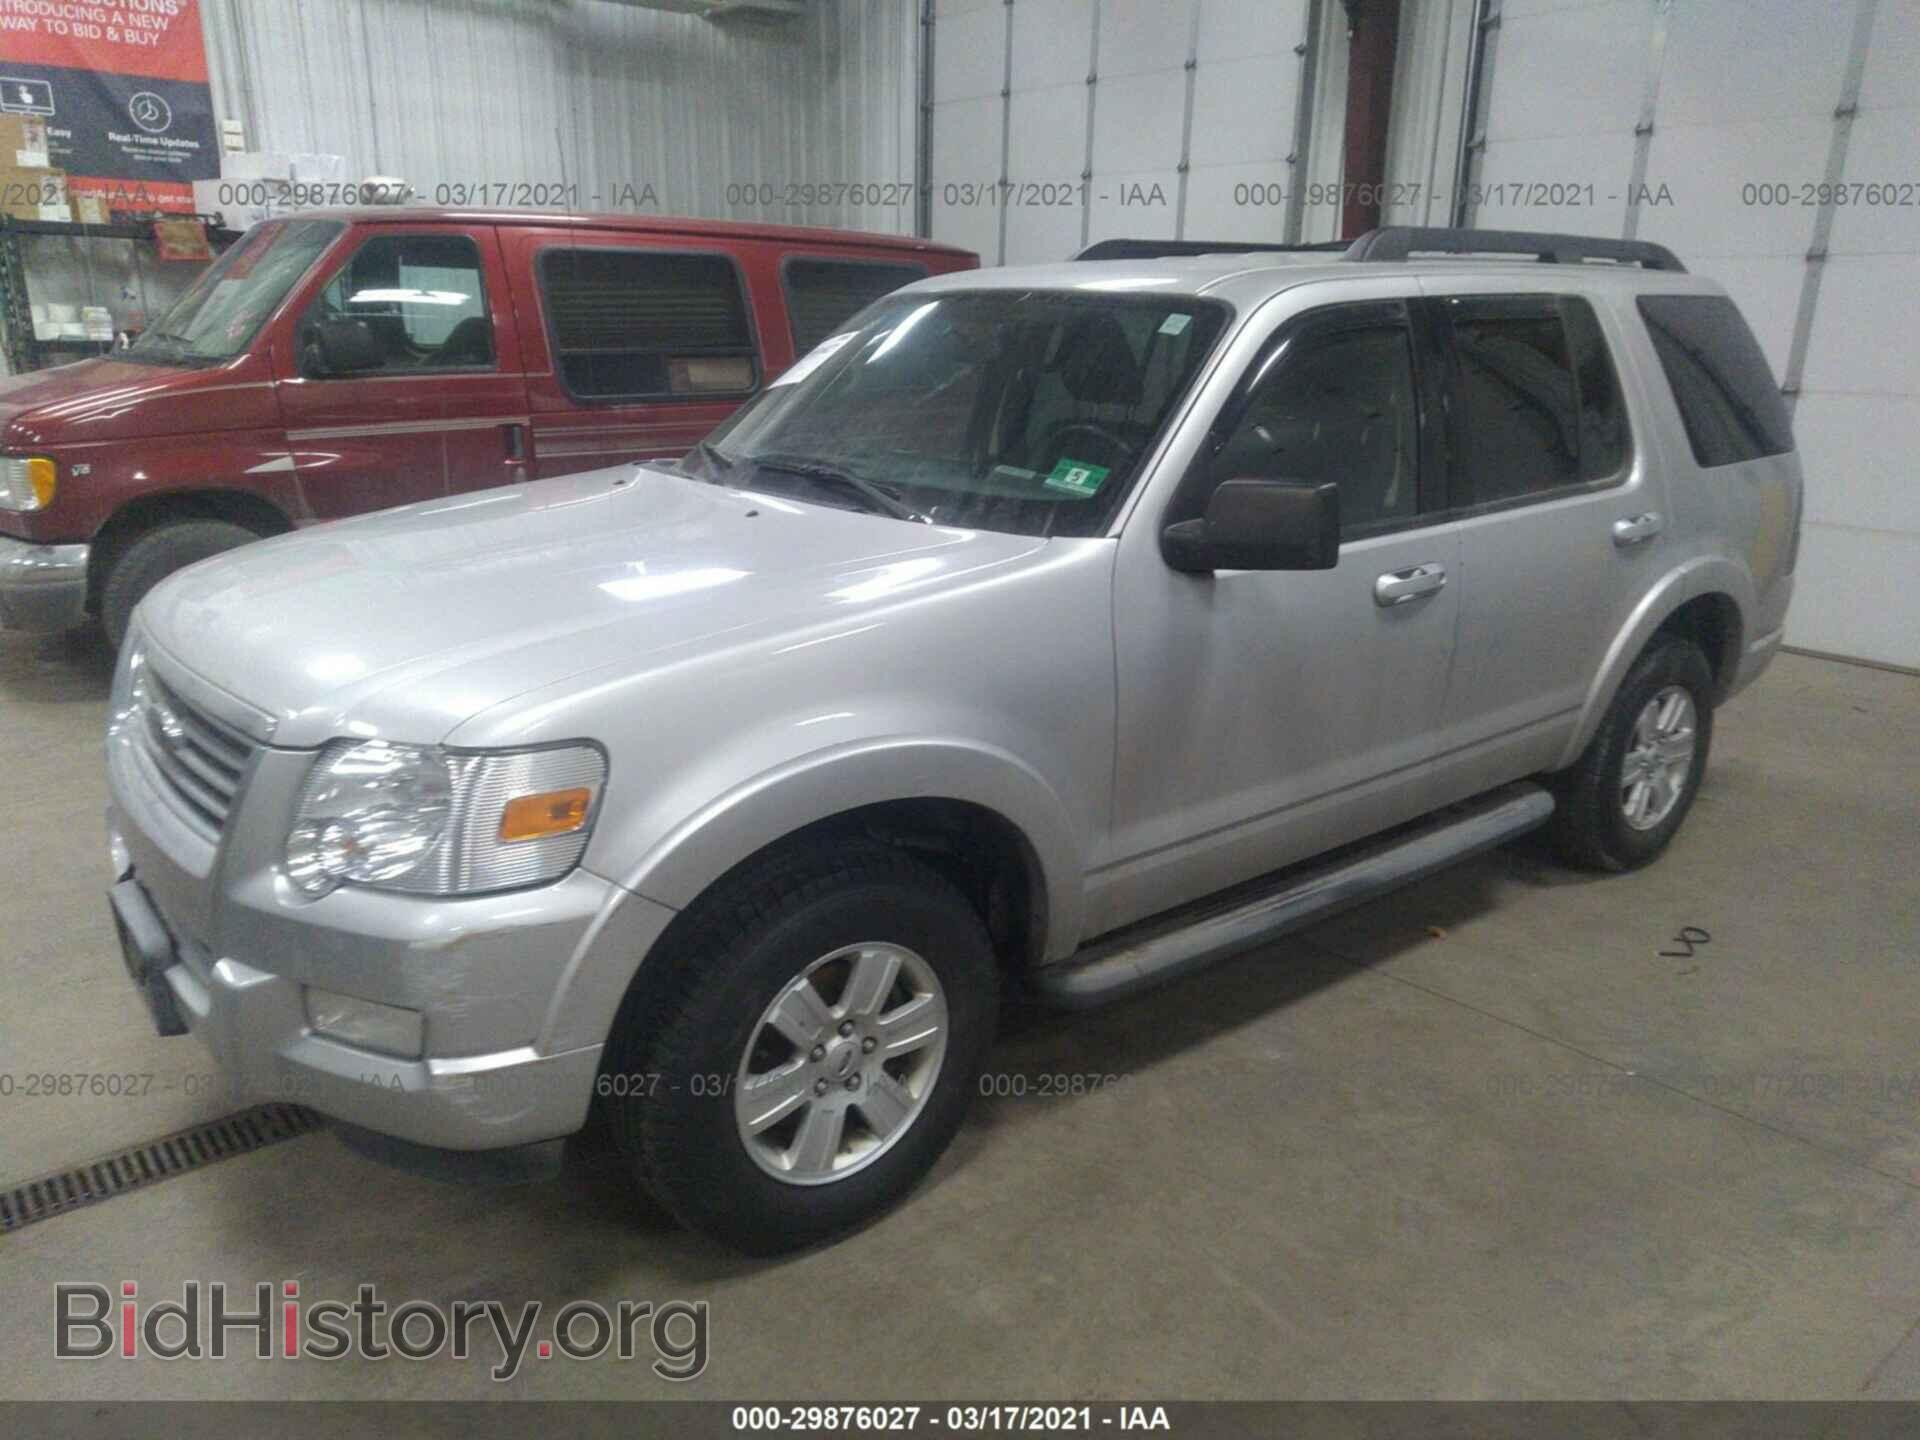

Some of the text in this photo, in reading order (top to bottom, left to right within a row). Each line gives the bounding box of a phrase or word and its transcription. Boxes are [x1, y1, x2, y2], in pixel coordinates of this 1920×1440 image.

[0, 0, 169, 31] TRODUCING A NEW
[0, 15, 160, 46] WAY TO BID & BUY
